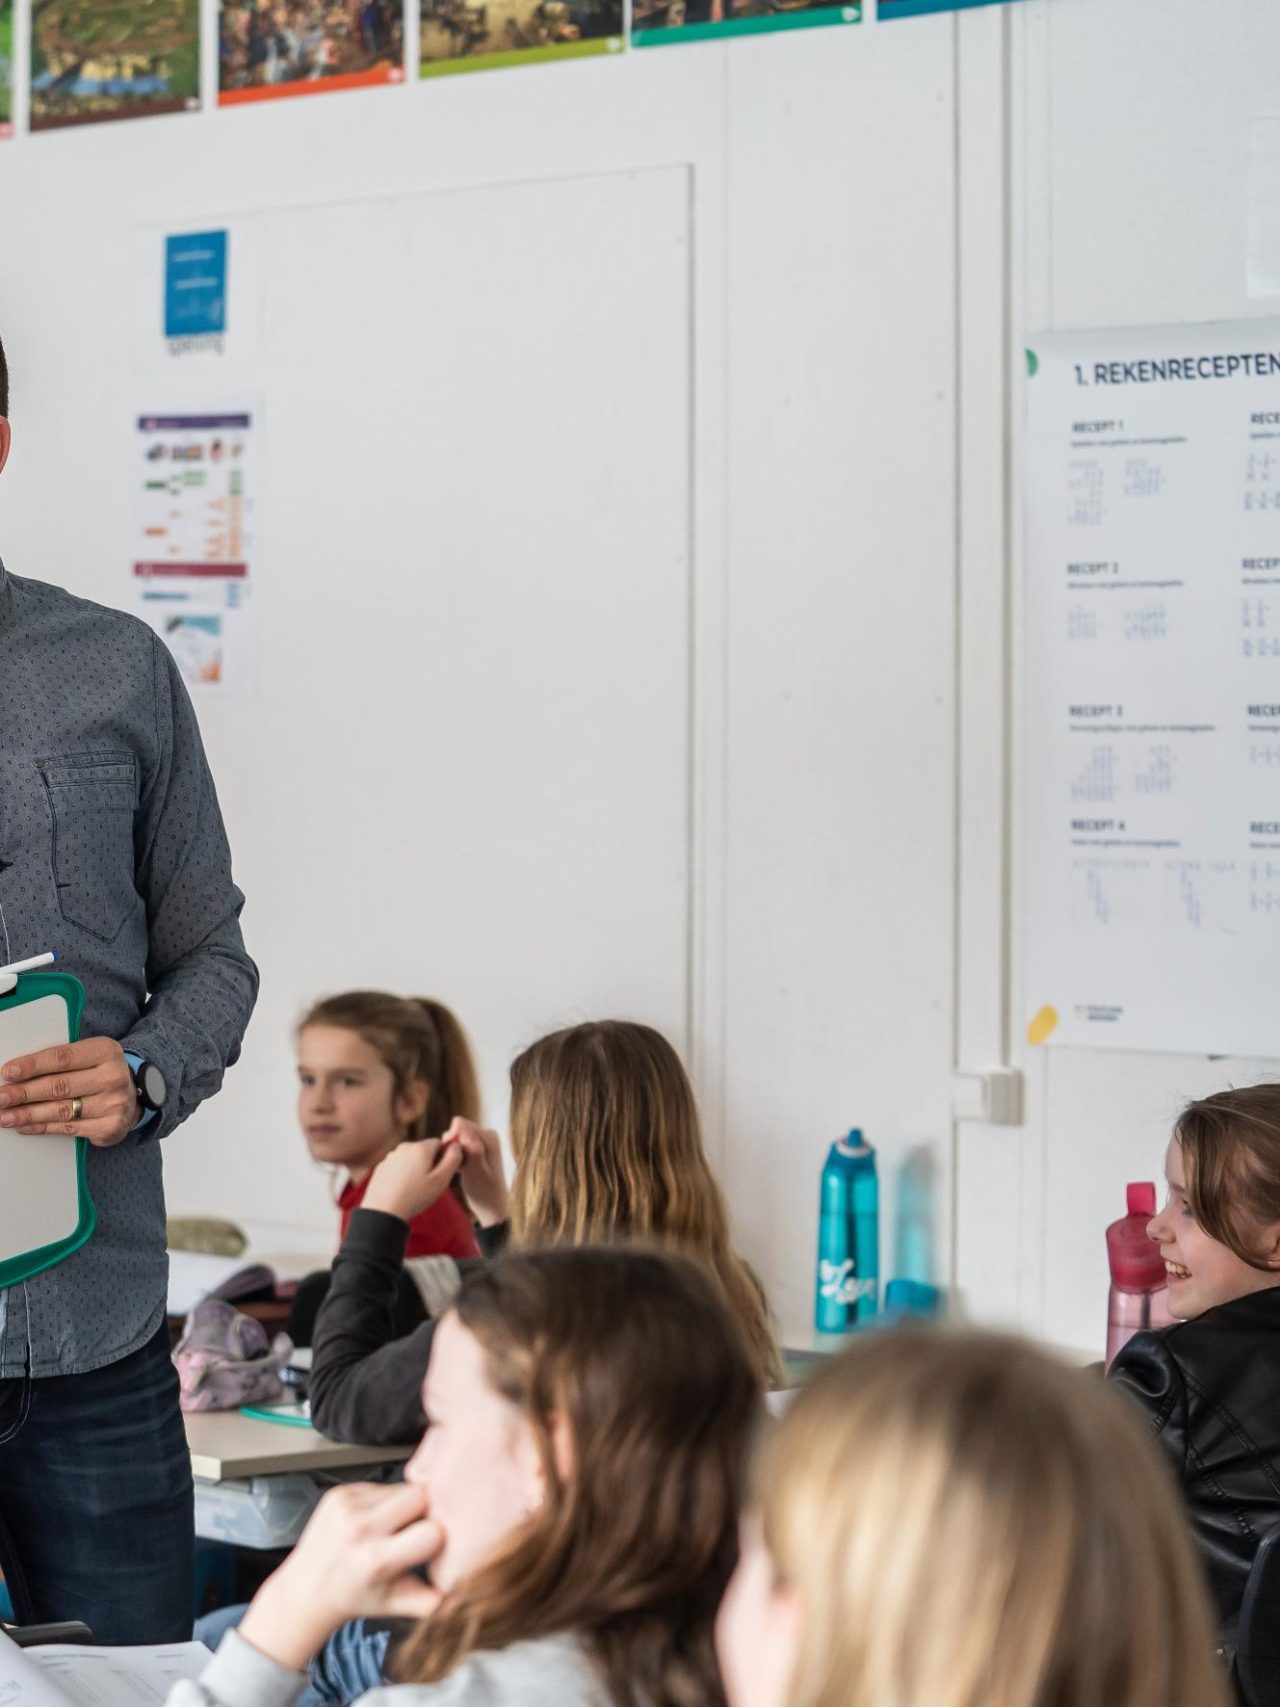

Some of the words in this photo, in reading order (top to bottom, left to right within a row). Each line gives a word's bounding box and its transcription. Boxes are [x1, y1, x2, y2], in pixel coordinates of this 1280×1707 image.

[1073, 364, 1089, 386] 1.
[1094, 353, 1280, 385] REKENRECEPTEN
[1072, 421, 1115, 433] RECEPT
[1067, 562, 1109, 574] RECEPT
[1070, 704, 1112, 717] RECEPT
[1071, 819, 1114, 831] RECEPT
